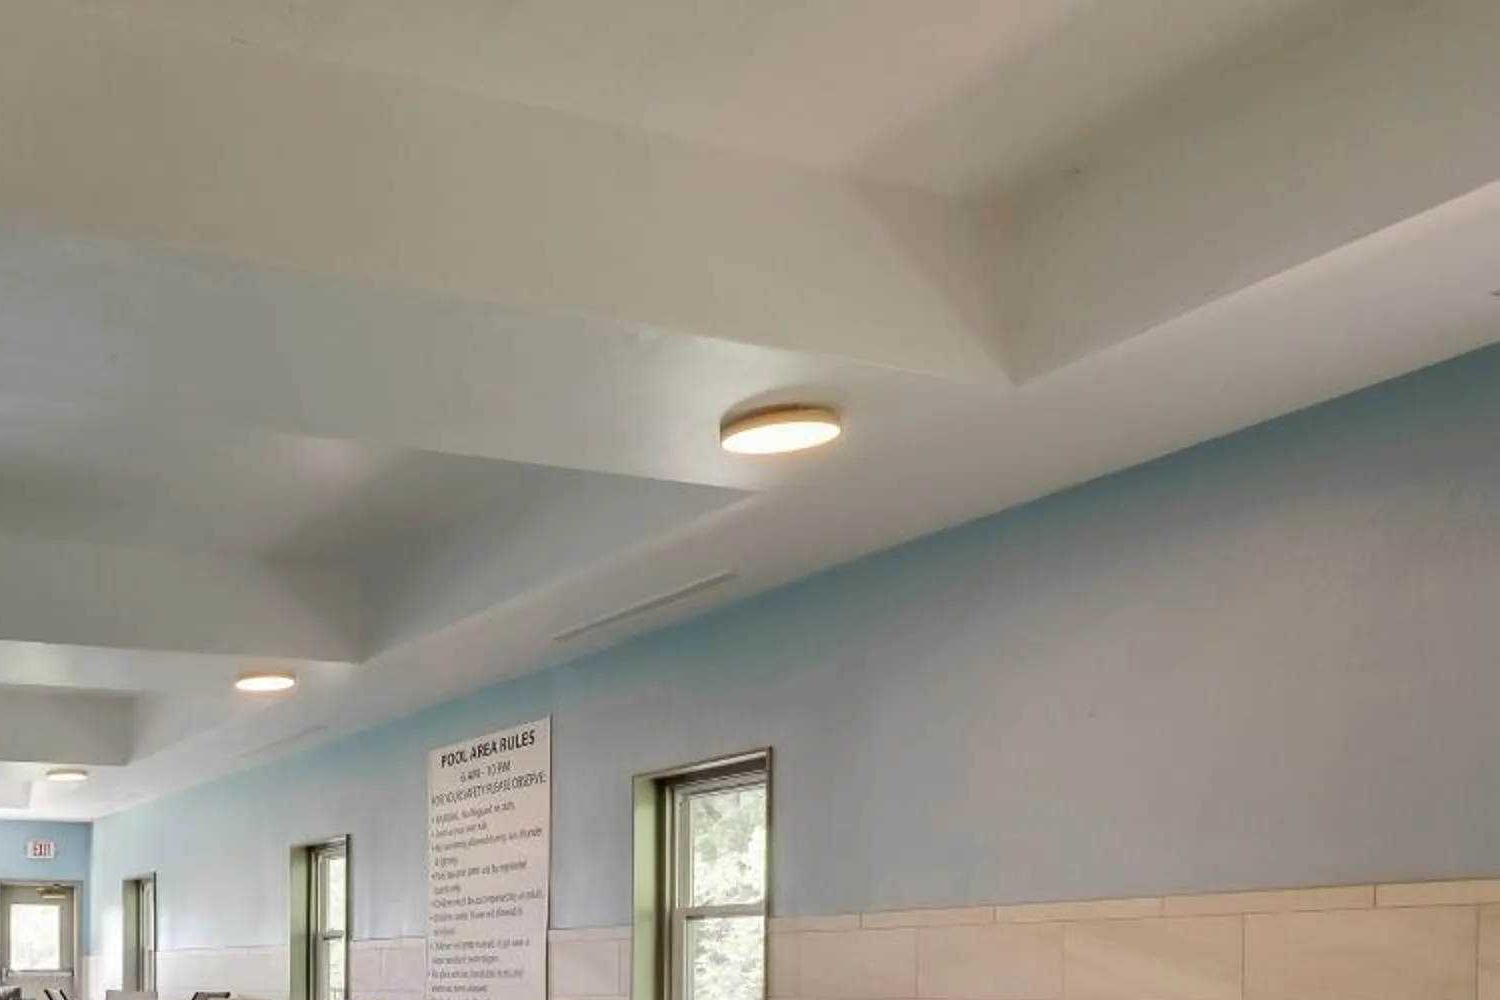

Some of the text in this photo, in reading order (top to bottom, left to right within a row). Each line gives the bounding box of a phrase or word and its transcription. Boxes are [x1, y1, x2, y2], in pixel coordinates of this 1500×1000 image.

[440, 728, 536, 768] POOL AREA RULES
